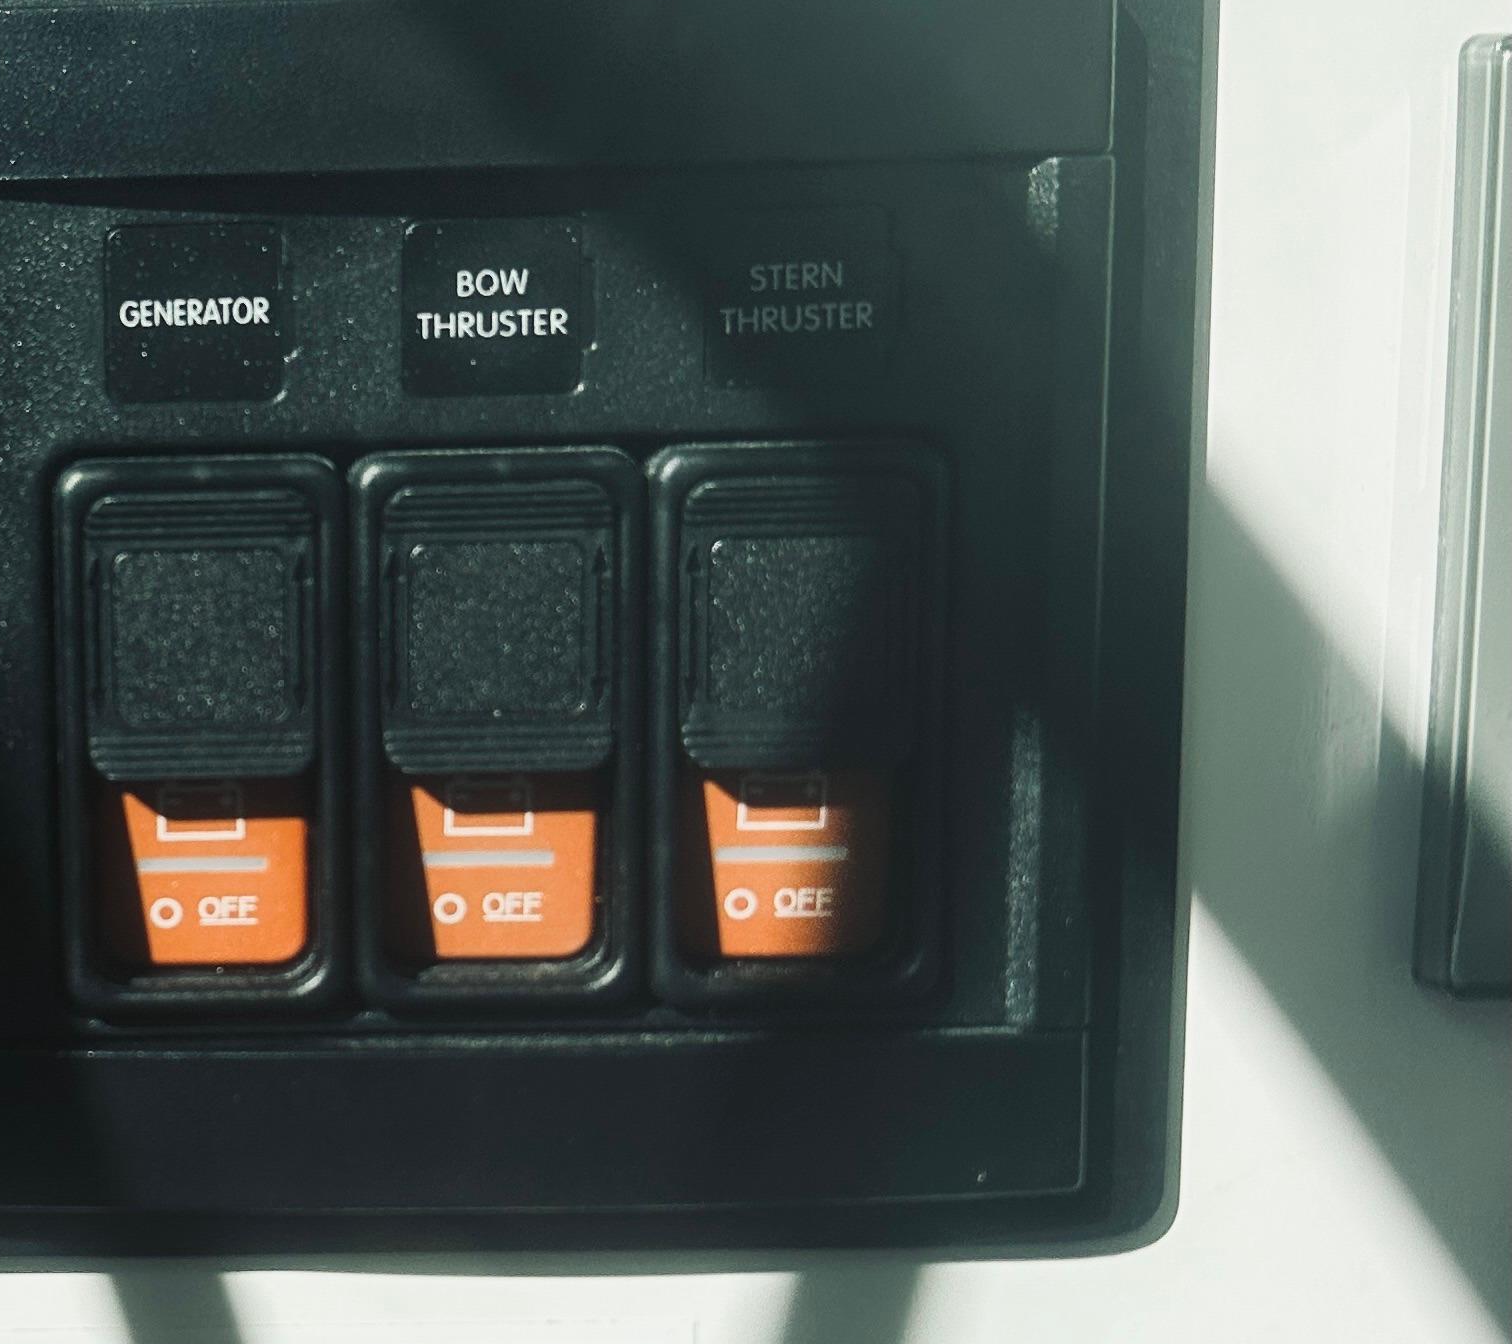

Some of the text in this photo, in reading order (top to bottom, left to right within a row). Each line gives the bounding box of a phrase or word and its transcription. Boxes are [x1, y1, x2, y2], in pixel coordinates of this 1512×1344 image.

[455, 268, 528, 299] BOW
[748, 261, 843, 294] STERN
[119, 296, 271, 328] GENERATOR
[416, 308, 570, 340] THRUSTER
[720, 300, 874, 334] THRUSTER
[198, 895, 258, 925] OFF
[482, 891, 543, 922] OFF
[773, 886, 834, 916] OFF
